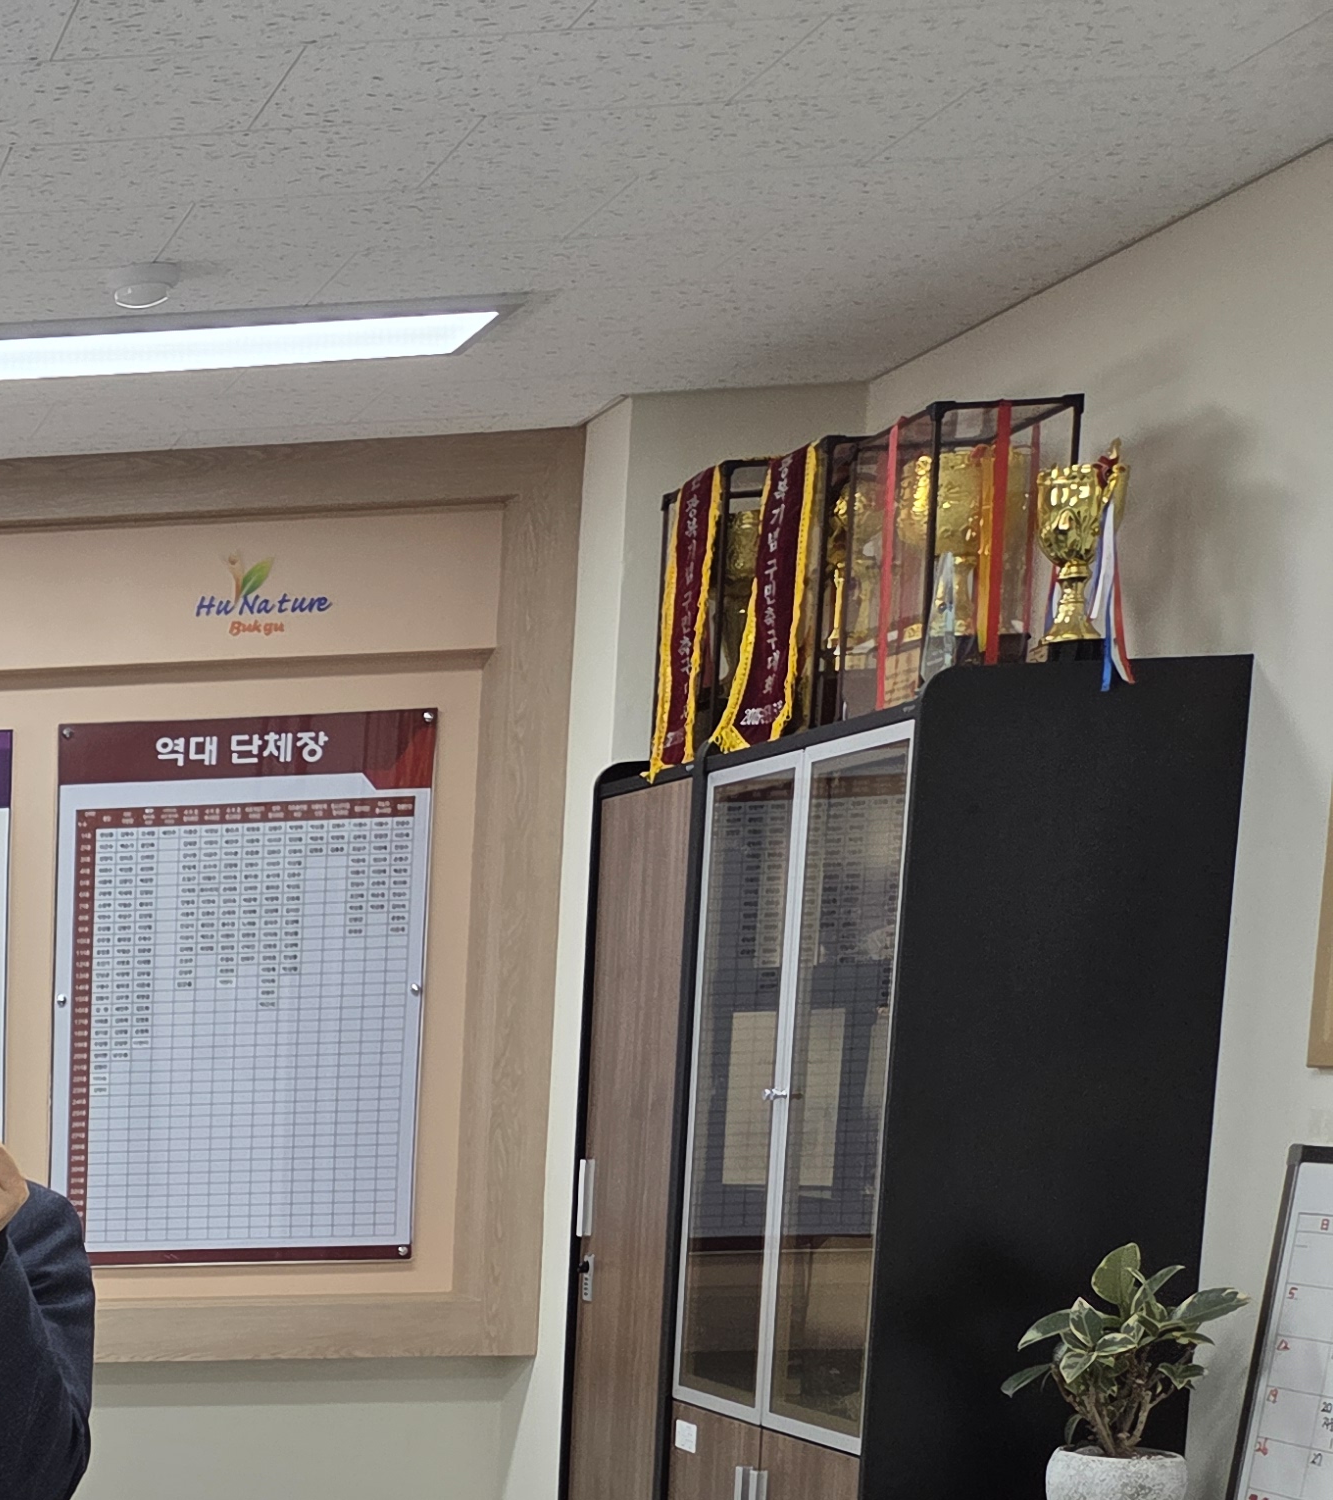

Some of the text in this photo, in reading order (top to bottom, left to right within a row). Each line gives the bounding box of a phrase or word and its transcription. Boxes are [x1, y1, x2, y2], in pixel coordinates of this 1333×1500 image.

[196, 593, 332, 617] Hu Nature
[155, 731, 329, 767] 역대 단체장
